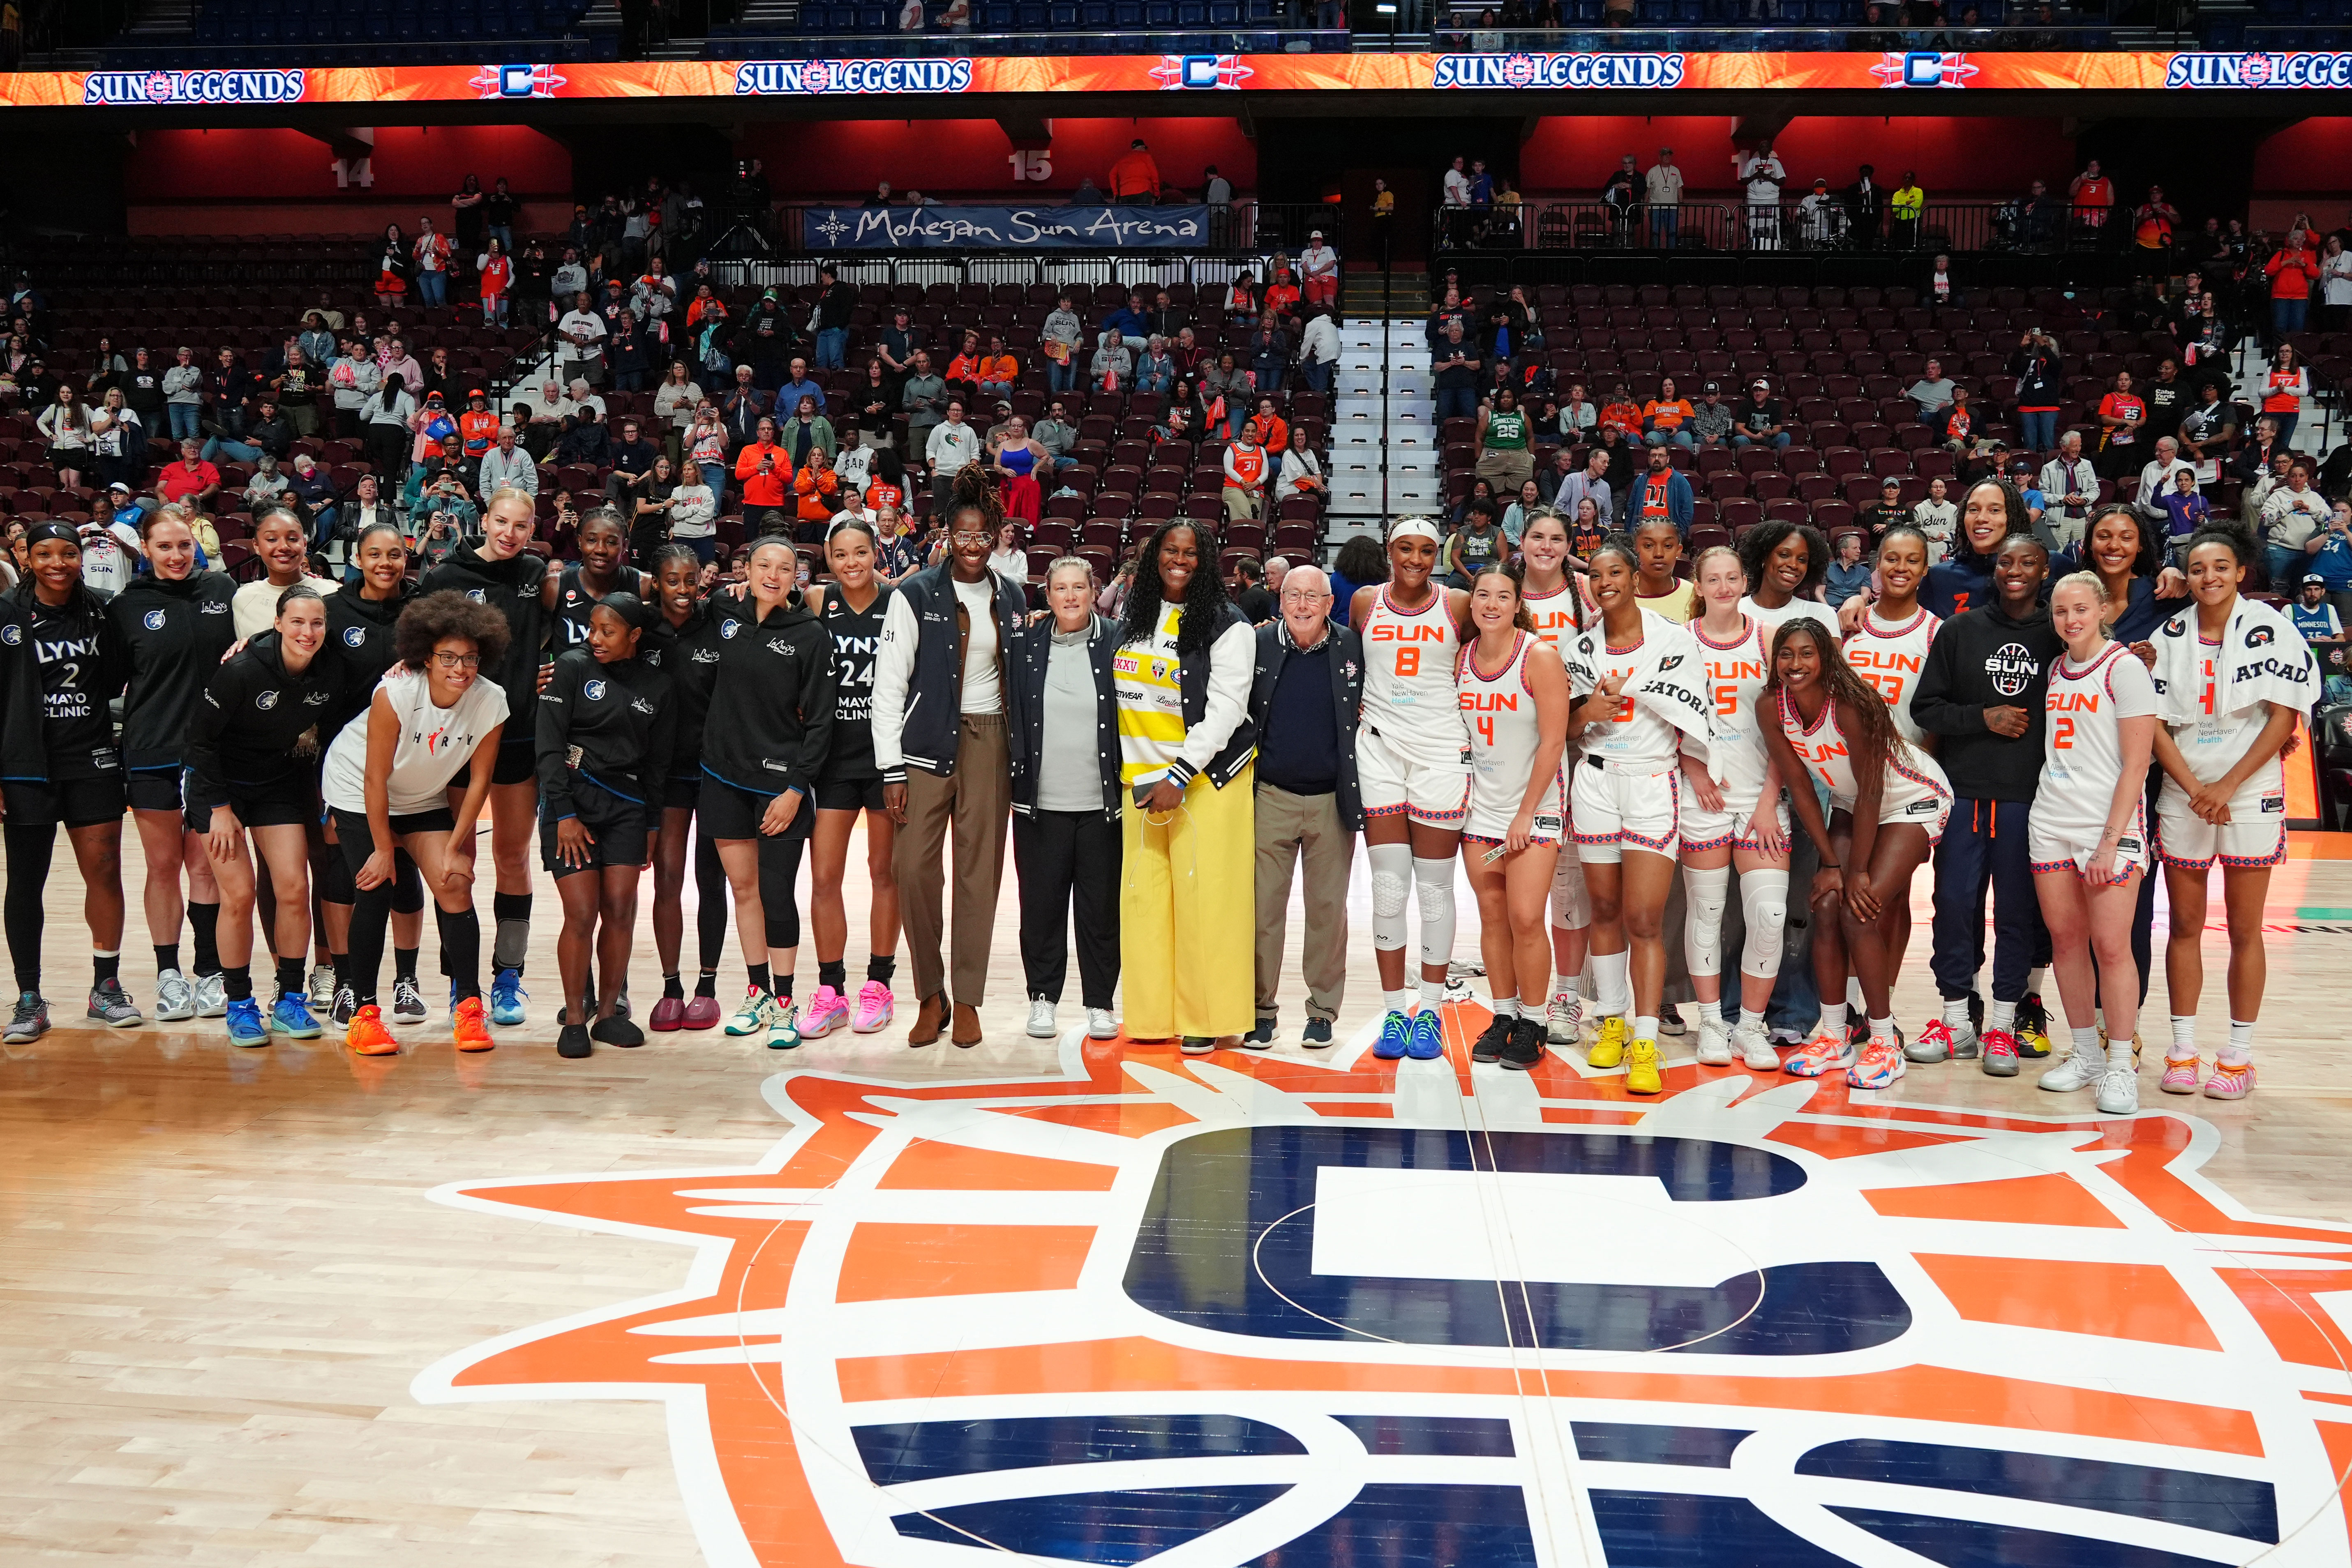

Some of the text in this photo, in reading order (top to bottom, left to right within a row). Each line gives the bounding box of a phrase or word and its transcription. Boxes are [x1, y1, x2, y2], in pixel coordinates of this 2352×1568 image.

[737, 62, 802, 92] SUN
[826, 60, 971, 90] LEGENDS
[1436, 55, 1505, 85] SUN
[1532, 53, 1684, 86] LEGENDS
[2168, 54, 2241, 87] SUN
[85, 71, 146, 102] SUN
[168, 70, 304, 101] LEGENDS
[331, 158, 374, 188] 14
[1009, 150, 1052, 181] 15
[855, 208, 1198, 246] Mohegan Sun Arena
[1492, 417, 1523, 427] CONNECTICUT
[2124, 409, 2138, 420] 25
[1497, 424, 1519, 438] 25
[2200, 423, 2207, 431] 5
[845, 458, 864, 470] GAP
[1244, 460, 1256, 471] 31
[879, 491, 895, 502] 22
[1924, 514, 1948, 526] Sun
[1576, 535, 1601, 551] SUN
[2323, 539, 2340, 553] 34
[1532, 611, 1578, 630] UN
[562, 617, 591, 644] LY
[884, 630, 894, 642] 31
[1371, 625, 1444, 643] SUN
[34, 632, 100, 664] LYNX
[833, 635, 880, 655] YNX
[1395, 647, 1420, 676] 8
[1704, 662, 1762, 679] SUN
[1849, 650, 1920, 673] SUN
[1985, 658, 2039, 675] SUN
[60, 663, 79, 688] 2
[840, 660, 874, 687] 24
[1987, 671, 2034, 679] BASKETBALL
[43, 693, 87, 705] MAYO
[1459, 692, 1517, 711] SUN
[1715, 685, 1738, 715] 5
[2046, 693, 2099, 713] SUN
[835, 709, 872, 720] CLINI
[1477, 716, 1493, 746] 4
[2054, 718, 2075, 749] 2
[2197, 736, 2222, 745] Health
[2198, 727, 2237, 736] NewHaven
[1791, 741, 1849, 763] SUN
[1818, 767, 1836, 786] 1
